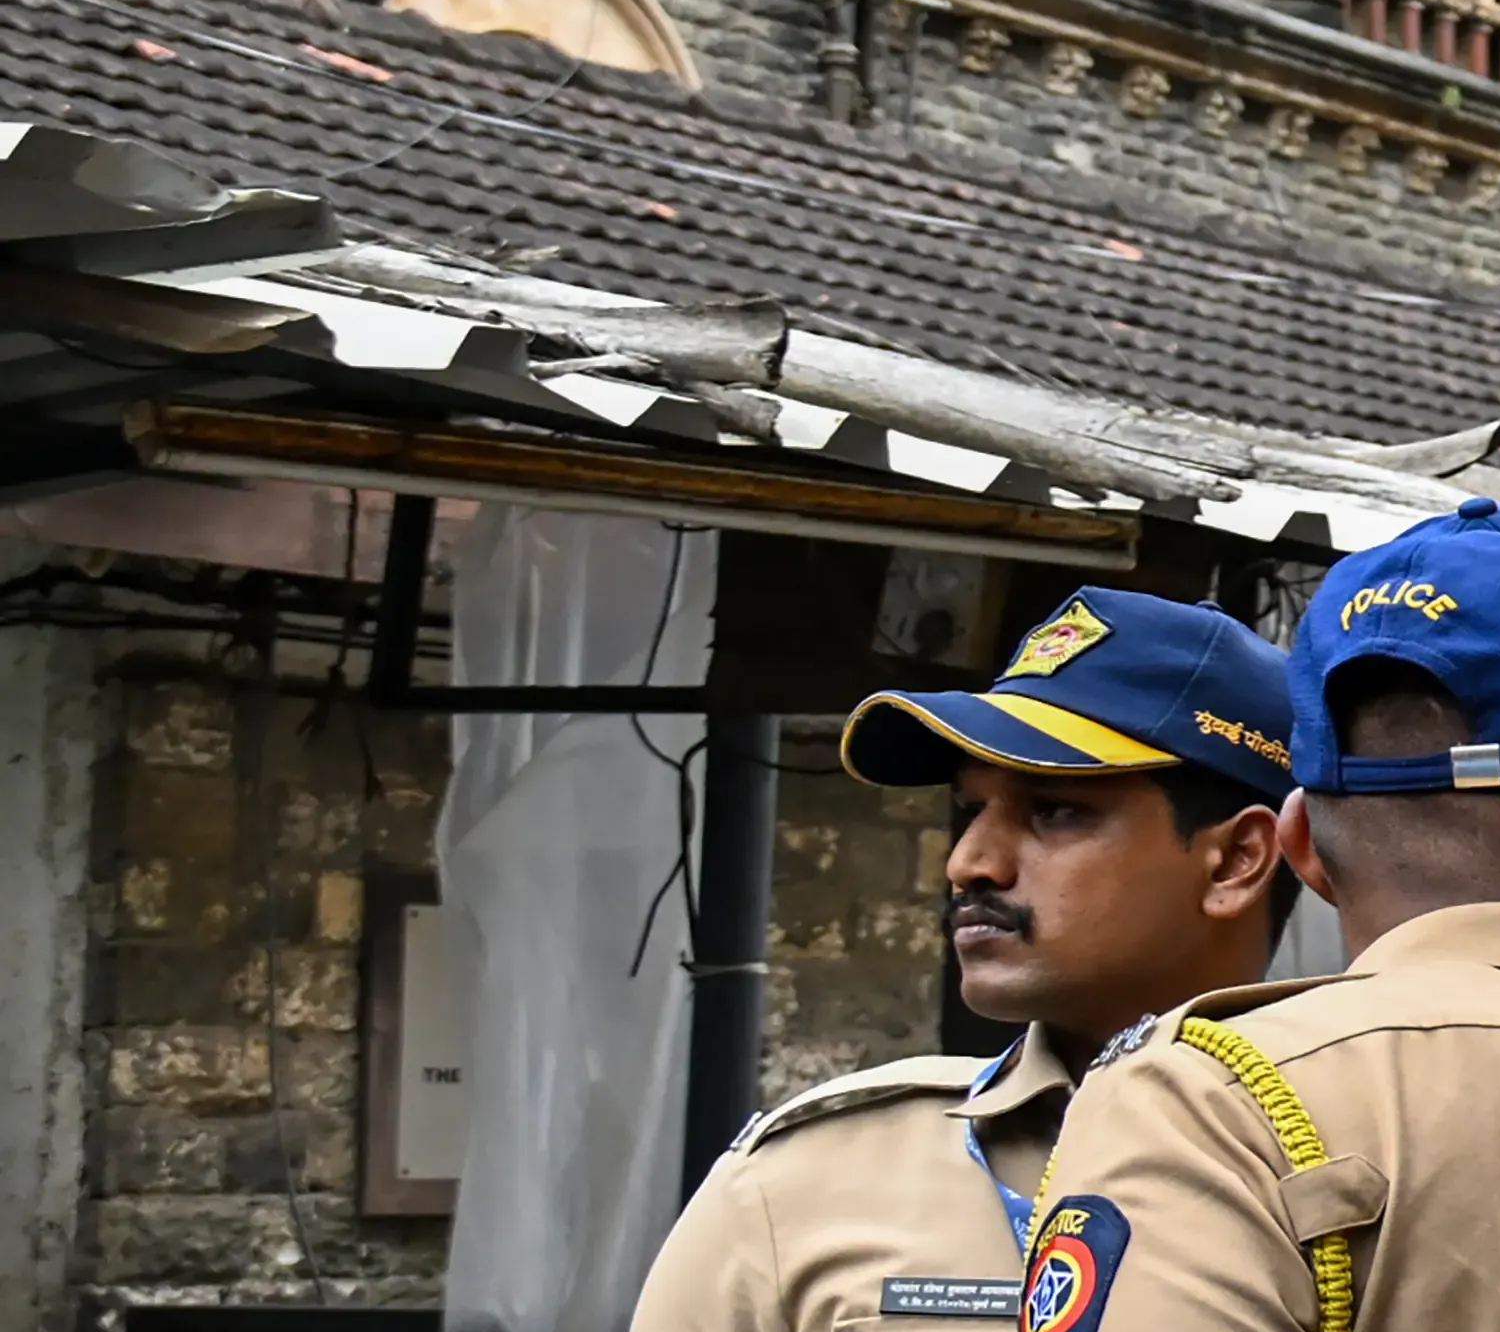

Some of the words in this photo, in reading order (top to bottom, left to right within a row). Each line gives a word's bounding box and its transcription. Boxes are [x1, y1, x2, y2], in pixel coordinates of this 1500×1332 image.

[1340, 579, 1458, 631] POLICE
[1193, 709, 1245, 745] मुंबई
[423, 1066, 462, 1085] THE
